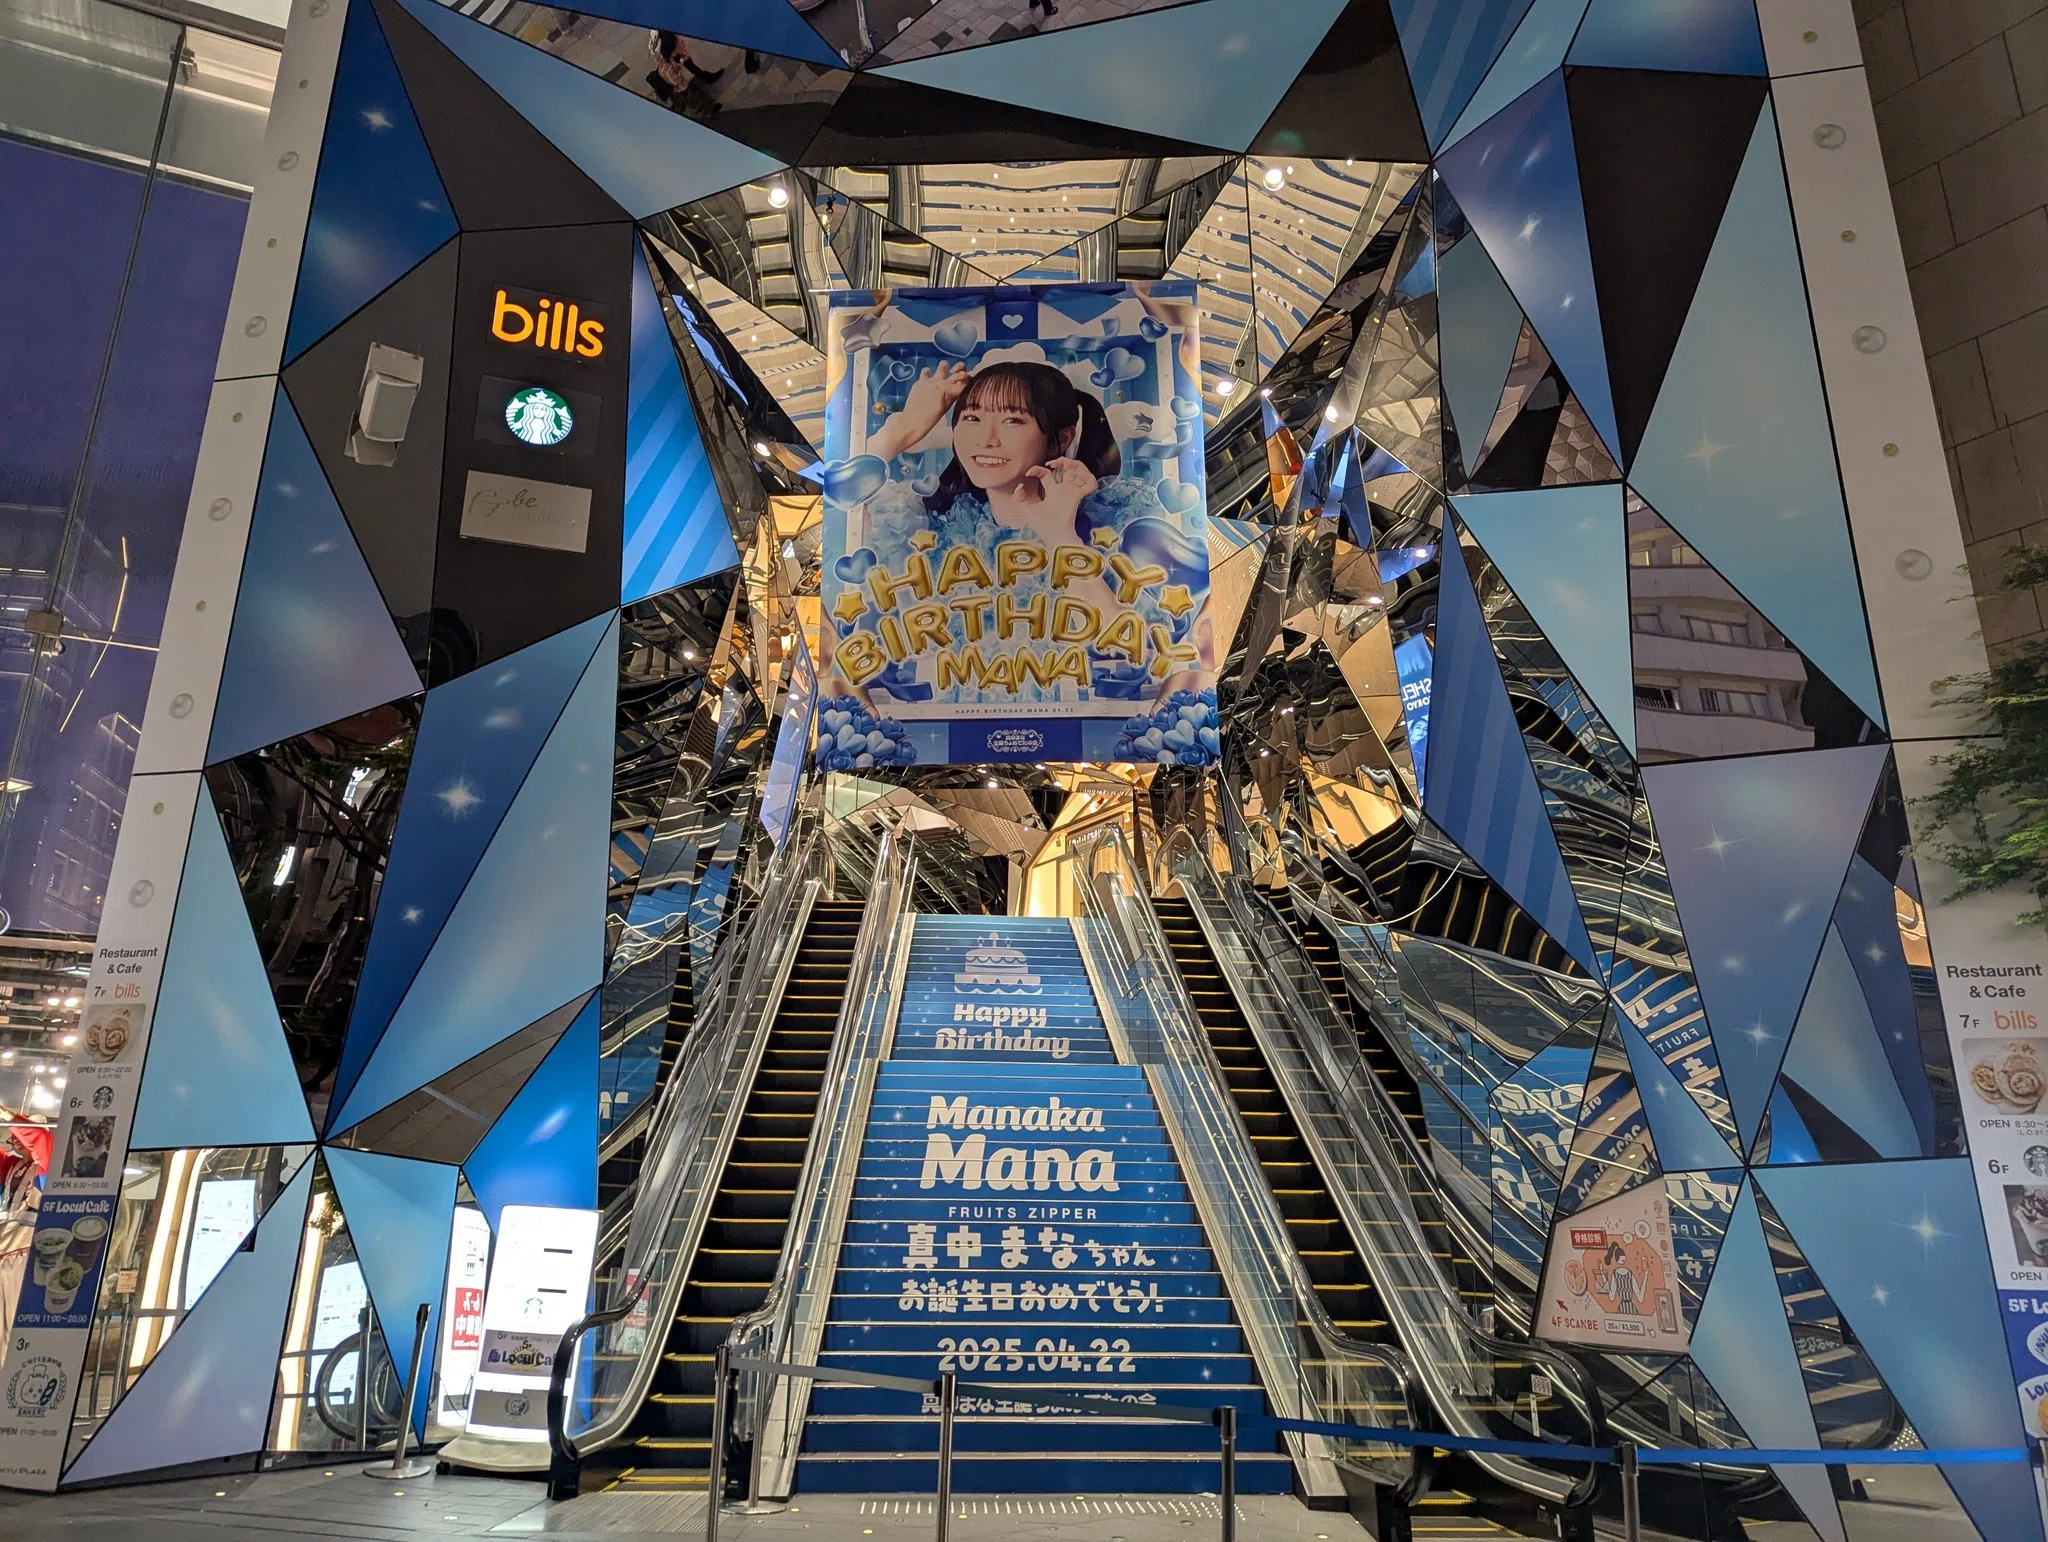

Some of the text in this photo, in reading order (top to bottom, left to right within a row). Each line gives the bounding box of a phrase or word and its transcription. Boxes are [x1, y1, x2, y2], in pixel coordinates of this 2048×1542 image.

[492, 290, 604, 357] bills
[870, 541, 1167, 612] HAPPY
[835, 596, 1198, 687] BIRTHDAY
[937, 645, 1091, 694] MANA
[100, 947, 158, 959] Restaurant
[107, 963, 142, 974] & Cafe
[1946, 964, 2043, 978] Restaurant
[94, 983, 140, 998] 7F bills
[1969, 985, 2026, 998] & Cafe
[954, 1003, 1047, 1027] Happy
[1959, 1010, 2038, 1030] 7F bills
[935, 1027, 1070, 1059] Birthday
[77, 1066, 96, 1074] OPEN
[70, 1096, 82, 1108] 6F
[926, 1095, 1105, 1131] Manaka
[1980, 1120, 2010, 1128] OPEN
[920, 1133, 1120, 1192] Mana
[1988, 1159, 2009, 1174] 6F
[948, 1206, 1097, 1219] FRUITS ZIPPER
[2011, 1271, 2042, 1281] OPEN
[2008, 1298, 2029, 1313] 5F
[17, 1314, 40, 1323] OPEN
[16, 1338, 30, 1352] 3F
[937, 1337, 1137, 1372] 2025.04.22
